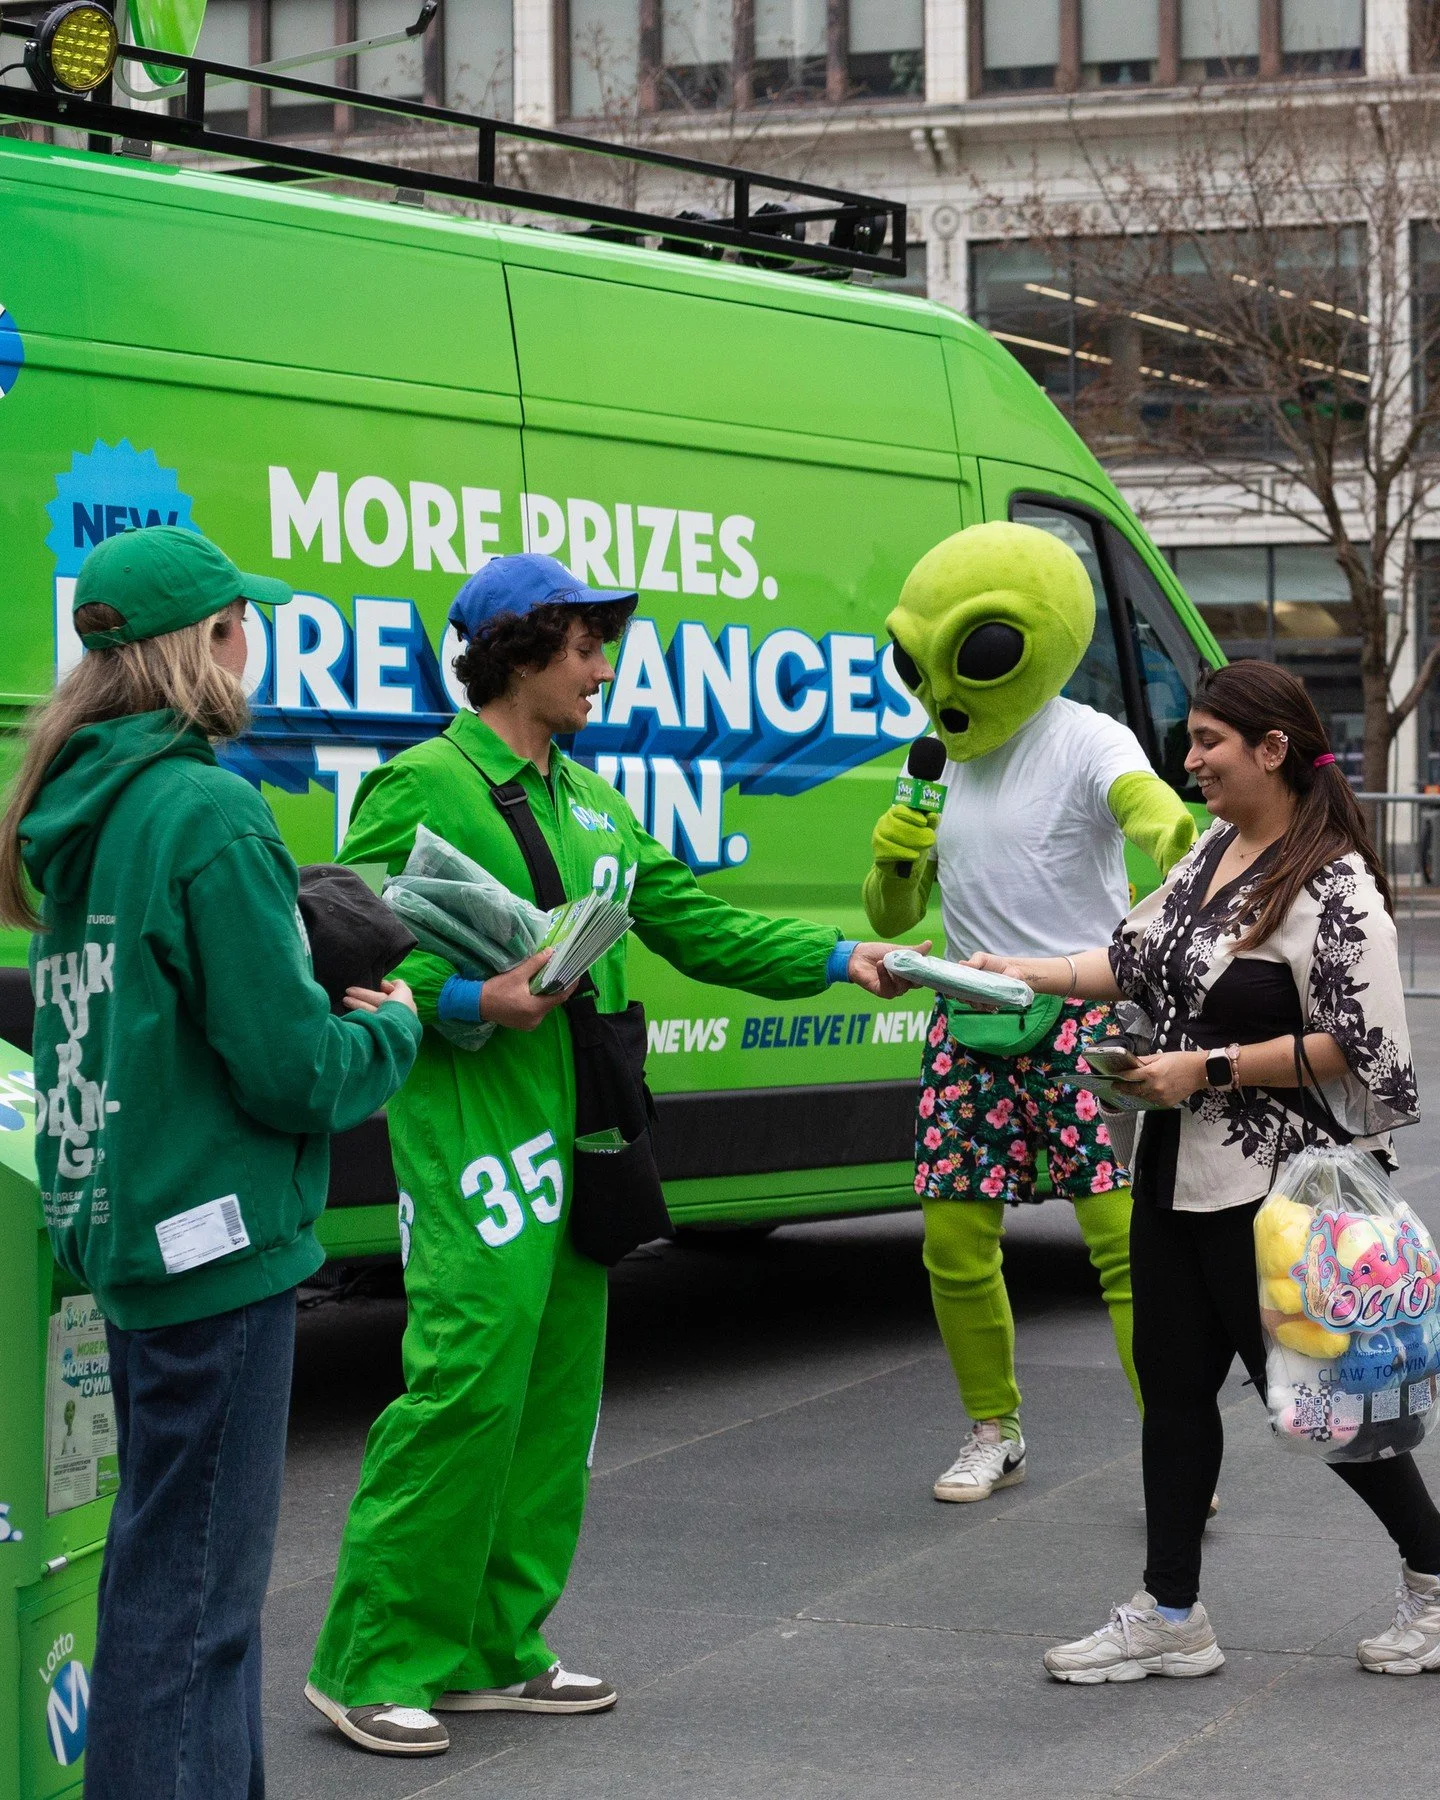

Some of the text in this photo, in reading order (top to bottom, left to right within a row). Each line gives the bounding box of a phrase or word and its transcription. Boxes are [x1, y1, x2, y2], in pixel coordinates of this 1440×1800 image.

[268, 465, 779, 601] MORE PRIZES.
[648, 1011, 933, 1054] NEWS BELIEVE IT NEW
[460, 1129, 564, 1248] 35
[62, 1360, 91, 1378] MORE
[1318, 1355, 1427, 1383] CLAW TO WIN
[39, 1632, 75, 1685] Lotto
